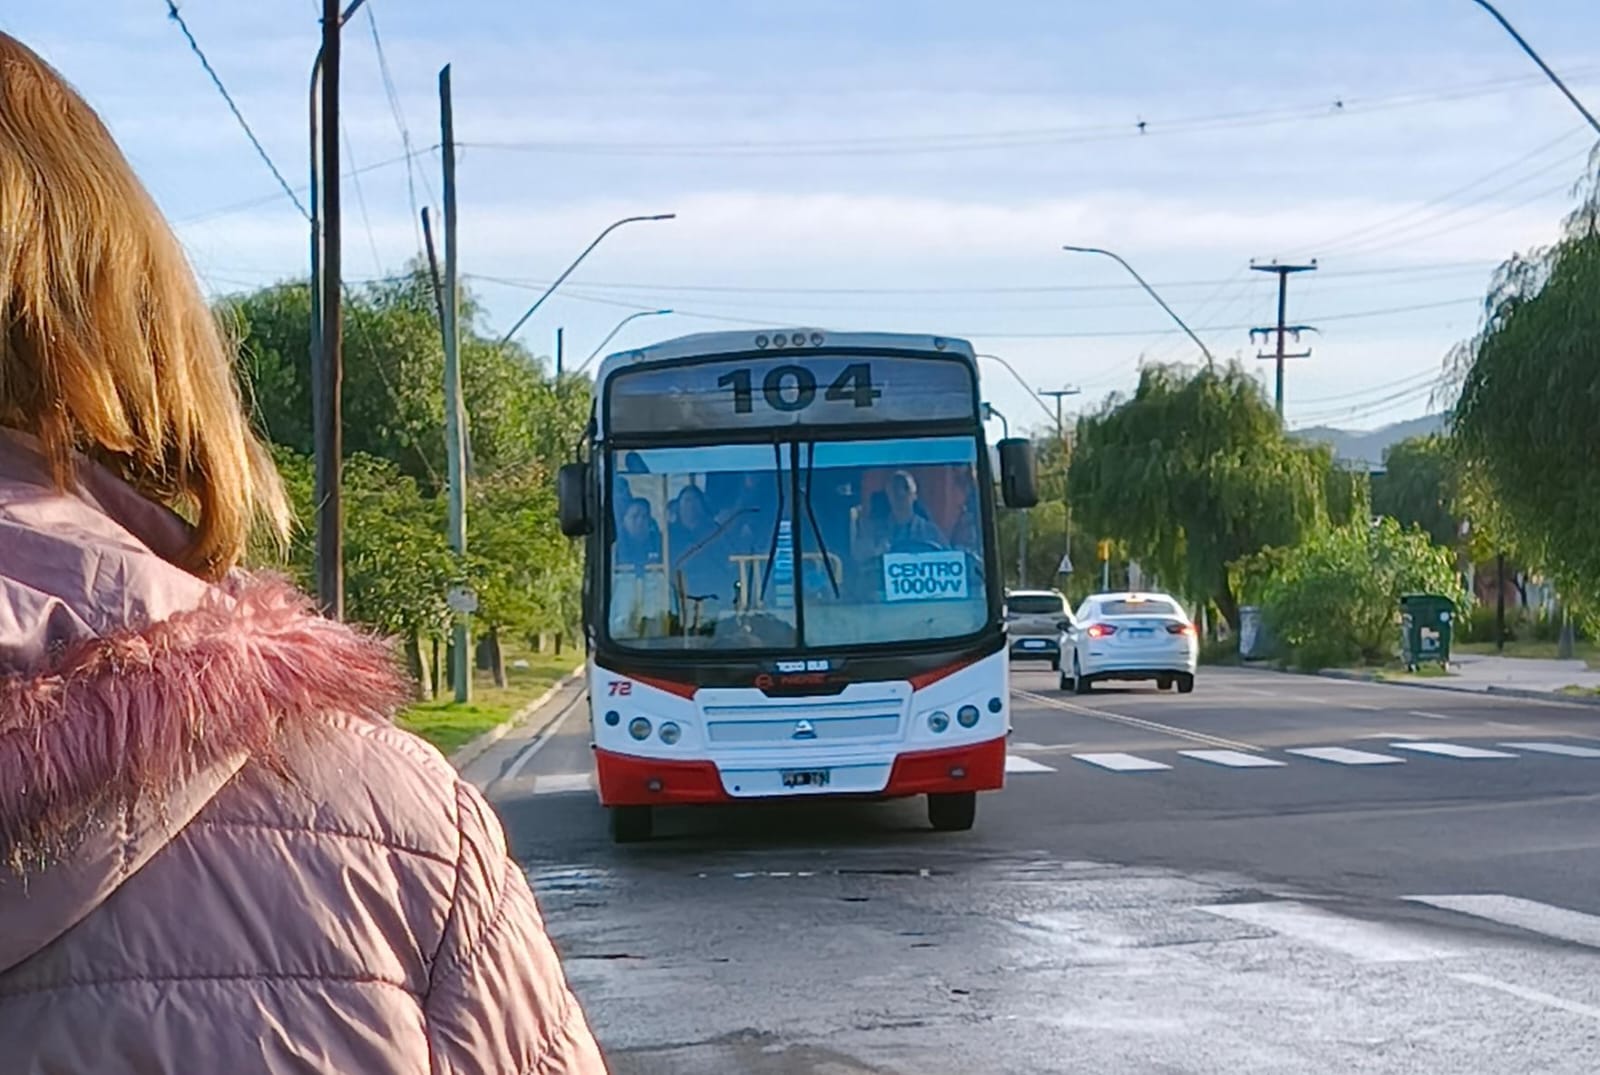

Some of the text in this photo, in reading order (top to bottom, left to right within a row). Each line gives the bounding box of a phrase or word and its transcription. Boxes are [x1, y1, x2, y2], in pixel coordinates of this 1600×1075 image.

[718, 363, 881, 413] 104
[888, 561, 963, 578] CENTRO
[608, 681, 632, 696] 72
